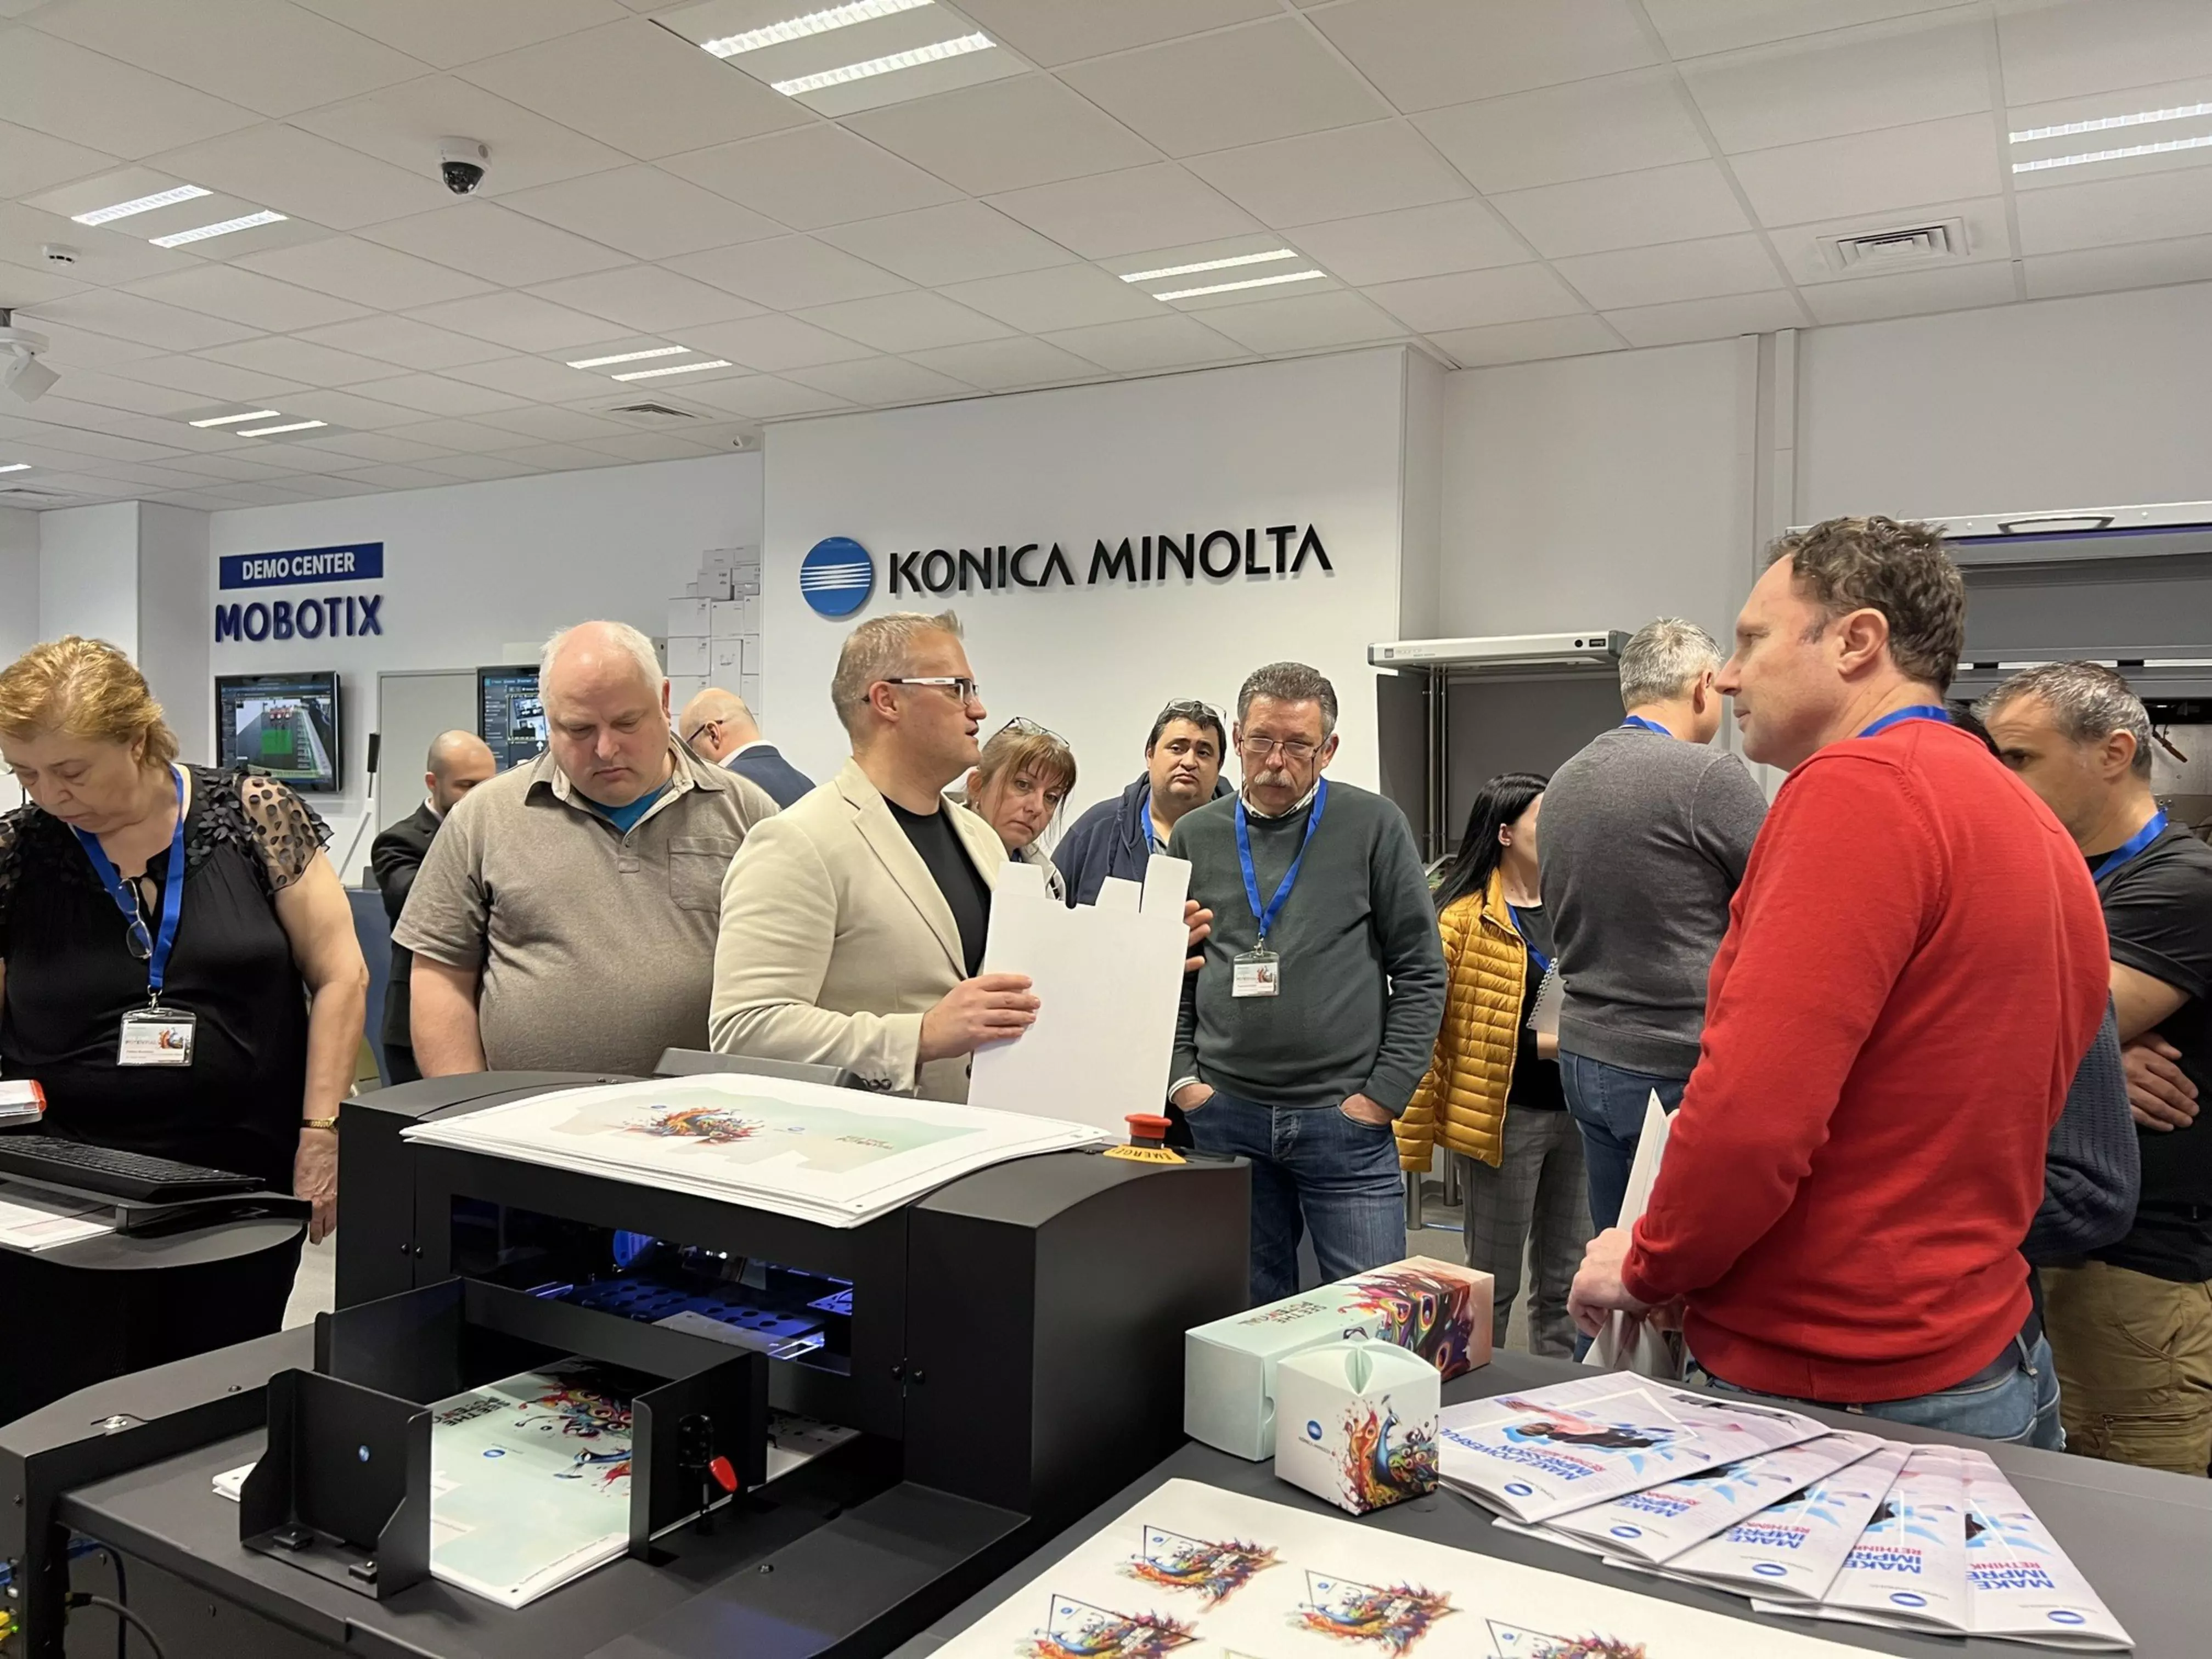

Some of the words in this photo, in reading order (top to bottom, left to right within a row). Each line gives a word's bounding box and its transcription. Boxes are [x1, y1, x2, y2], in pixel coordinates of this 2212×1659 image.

[242, 557, 290, 581] DEMO
[291, 551, 356, 577] CENTER
[888, 541, 1075, 594] KONICA
[1087, 523, 1333, 585] MINOLTA
[215, 594, 382, 643] MOBOTIX
[1439, 1427, 1526, 1463] POWERFUL
[1496, 1444, 1595, 1477] IMPRESSION
[1540, 1462, 1581, 1480] MAKE
[1725, 1535, 1802, 1549] MAKE
[1842, 1560, 1922, 1575] MAKE
[1969, 1561, 2041, 1570] RETHINK
[1965, 1569, 2049, 1581] IMPRE
[1978, 1579, 2056, 1590] MAKE
